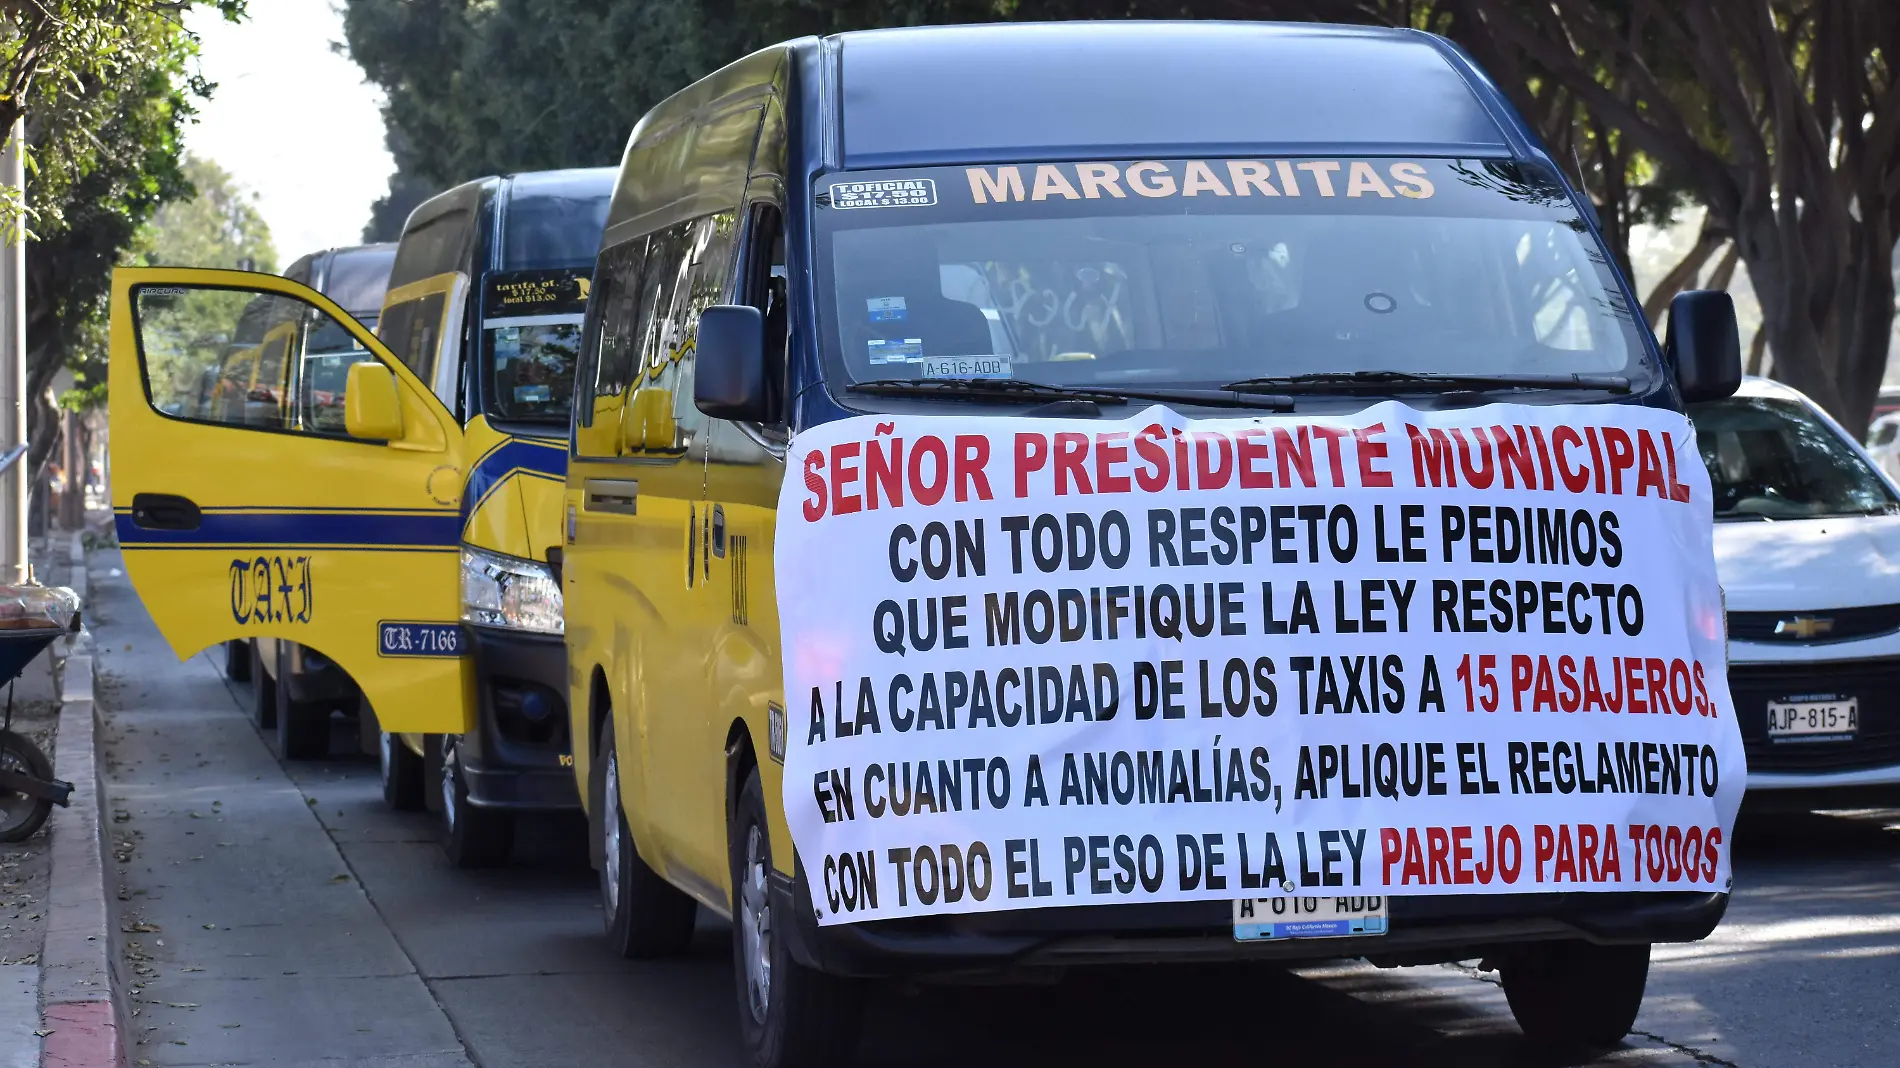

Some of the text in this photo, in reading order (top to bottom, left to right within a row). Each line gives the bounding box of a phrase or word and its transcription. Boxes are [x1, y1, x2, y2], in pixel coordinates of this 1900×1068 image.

[837, 182, 926, 193] T.OFICIAL
[840, 199, 878, 207] LOCAL
[841, 190, 927, 200] $17.50
[966, 161, 1434, 203] MARGARITAS
[496, 281, 536, 291] tarifa
[926, 361, 1001, 376] A-616-ADB
[802, 422, 1690, 523] SEÑOR PRESIDENTE MUNICIPAL
[889, 504, 1622, 583] CON TODO RESPETO LE PEDIMOS
[230, 556, 312, 624] TAXI
[873, 579, 1643, 657] QUE MODIFIQUE LA LEY RESPECTO
[807, 687, 826, 745] A
[835, 677, 881, 737] LA
[888, 662, 1119, 732] CAPACIDAD
[1134, 660, 1185, 720] DE
[1200, 657, 1277, 718] LOS
[1290, 655, 1403, 714] TAXIS
[1419, 655, 1445, 713] A
[1456, 654, 1499, 713] 15
[1511, 655, 1717, 718] PASAJEROS.
[1769, 706, 1856, 730] AJP-815-A
[814, 735, 1718, 823] EN CUANTO A ANOMALÍAS, APLIQUE EL REGLAMENTO
[824, 824, 1722, 914] CON TODO EL PESO DE LA LEY PAREJO PARA TODOS
